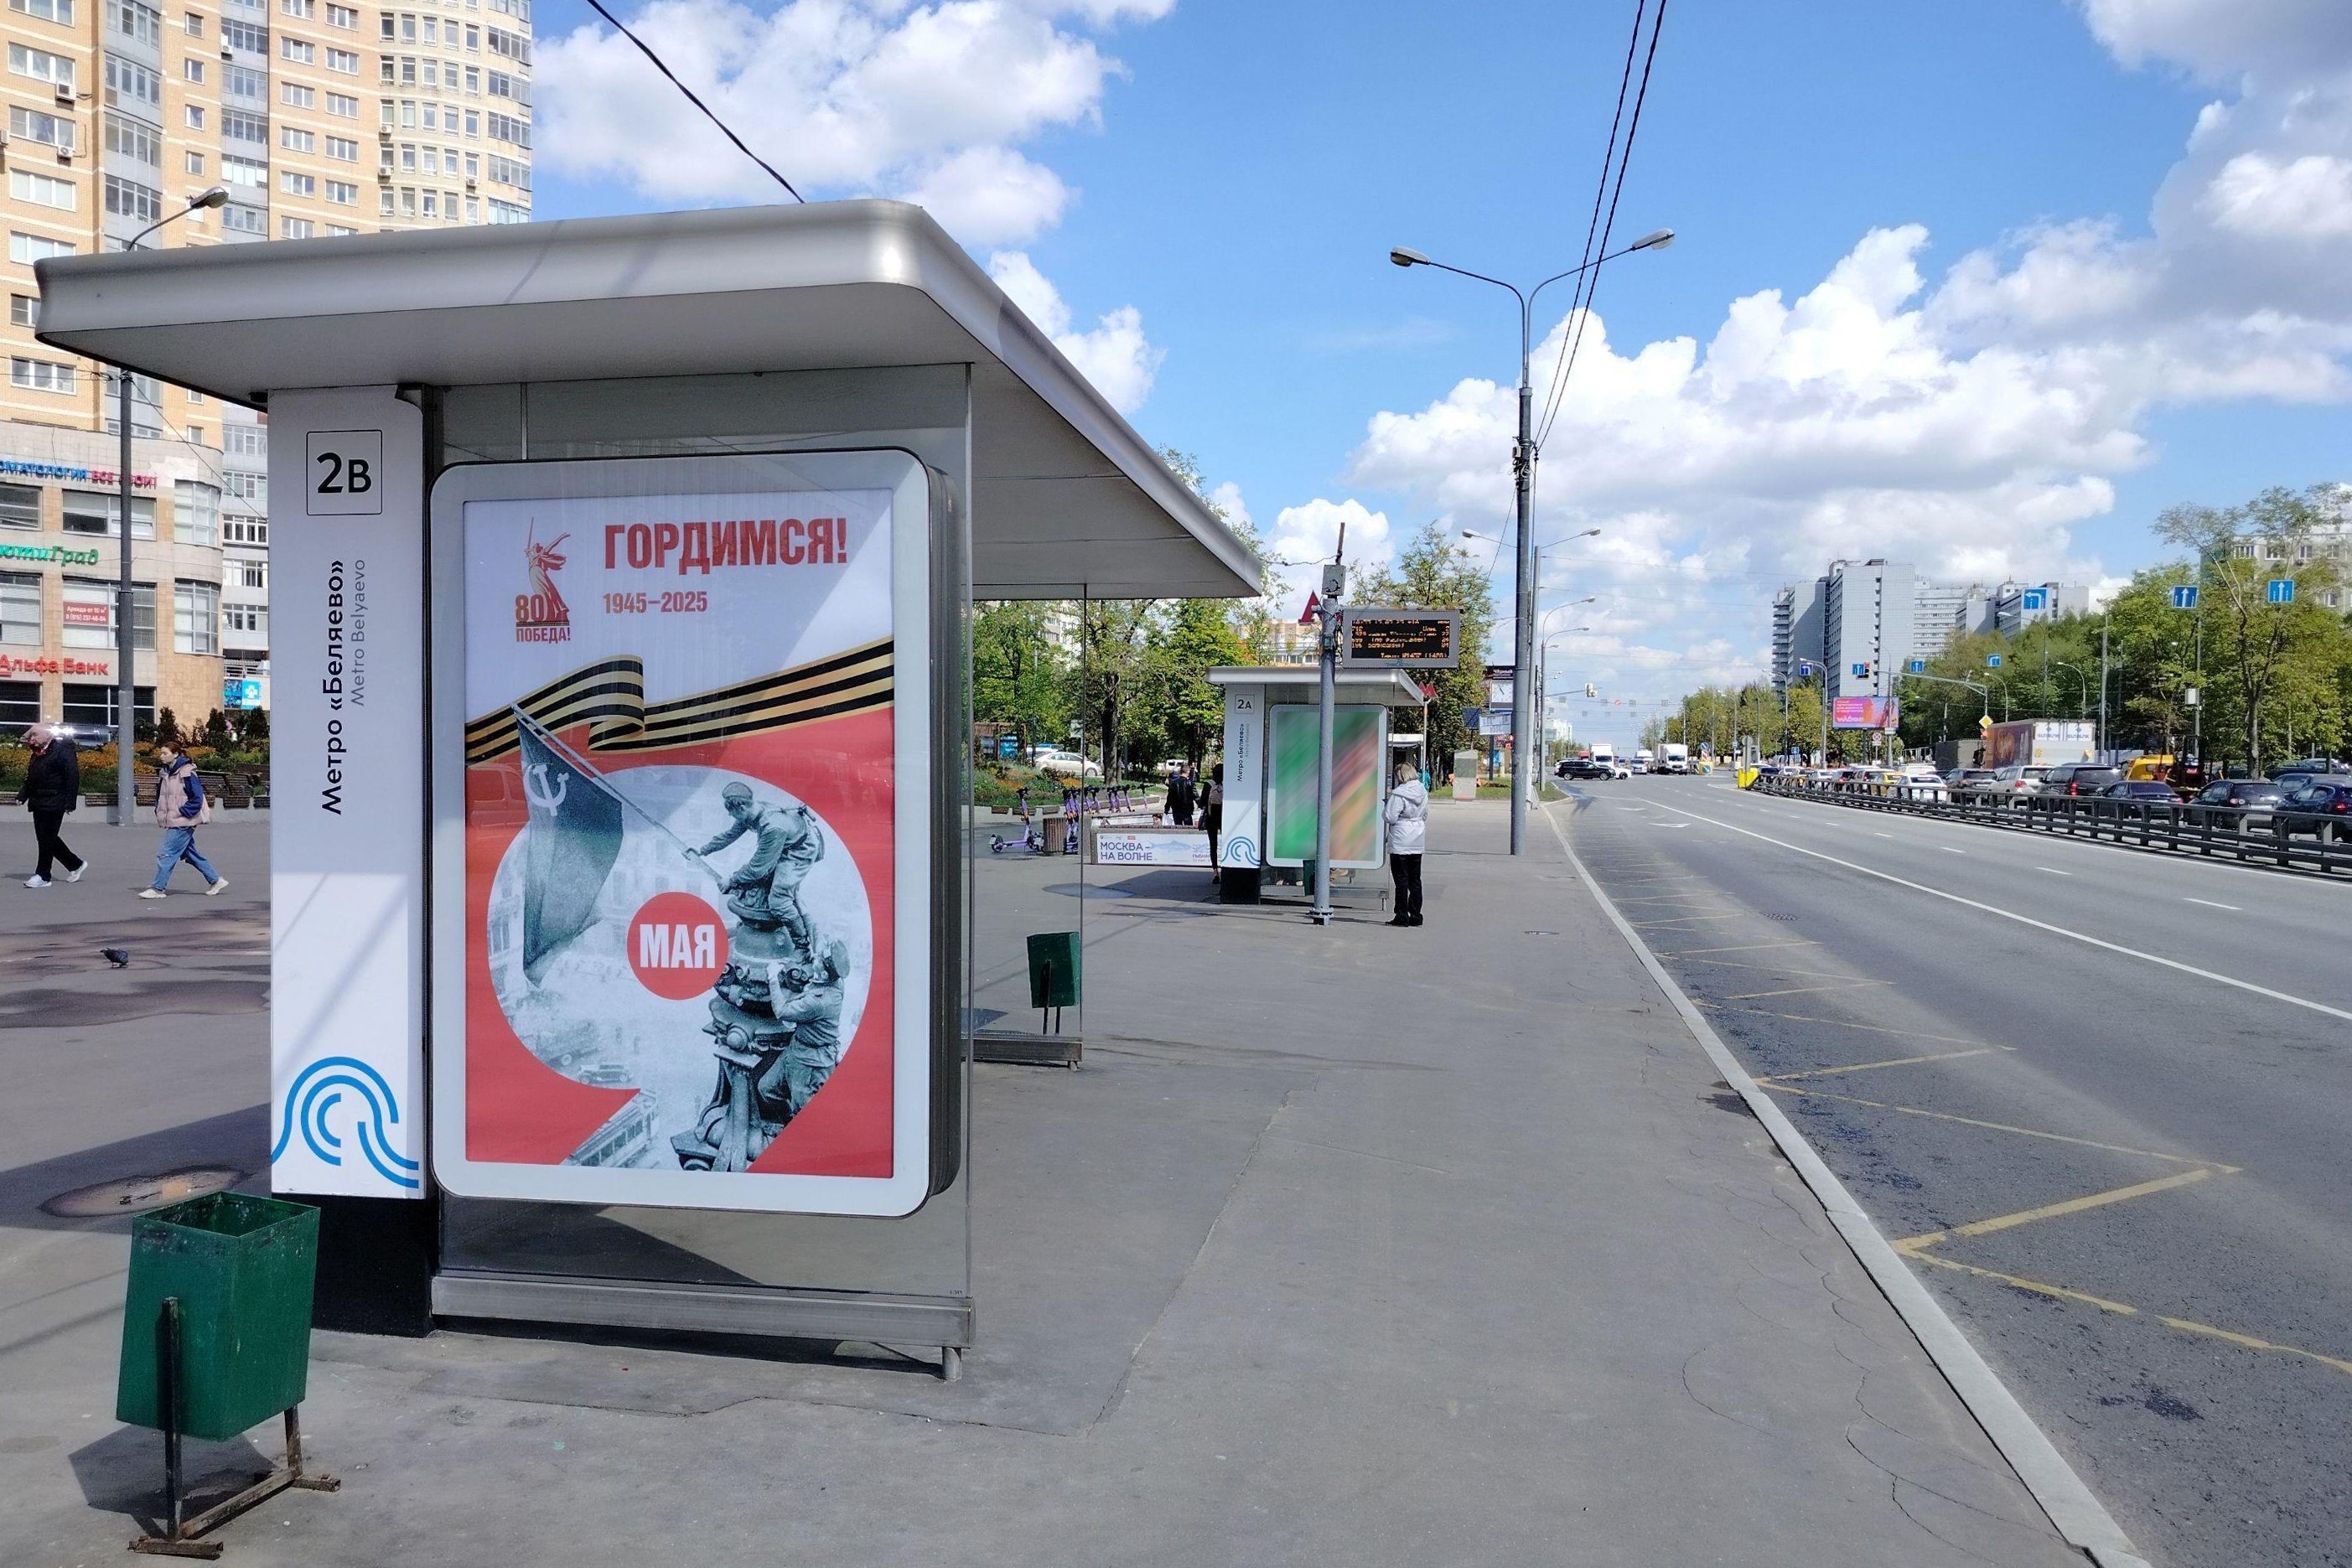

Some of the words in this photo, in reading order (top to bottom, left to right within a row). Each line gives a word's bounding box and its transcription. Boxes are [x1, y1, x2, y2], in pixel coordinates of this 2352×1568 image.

[91, 470, 114, 485] ВСЕ
[604, 518, 847, 575] ГОРДИМСЯ!
[351, 559, 369, 642] Belyaevo
[515, 594, 544, 622] 80
[323, 559, 344, 712] «Беляево»
[515, 626, 571, 644] ПОБЕДА!
[0, 655, 59, 675] Альфа
[64, 658, 108, 675] Банк
[350, 649, 365, 706] Metro
[321, 719, 347, 815] Метро
[1101, 842, 1143, 851] МОСКВА
[1101, 852, 1114, 861] НА
[1117, 852, 1153, 861] ВОЛНЕ
[640, 924, 716, 969] МАЯ
